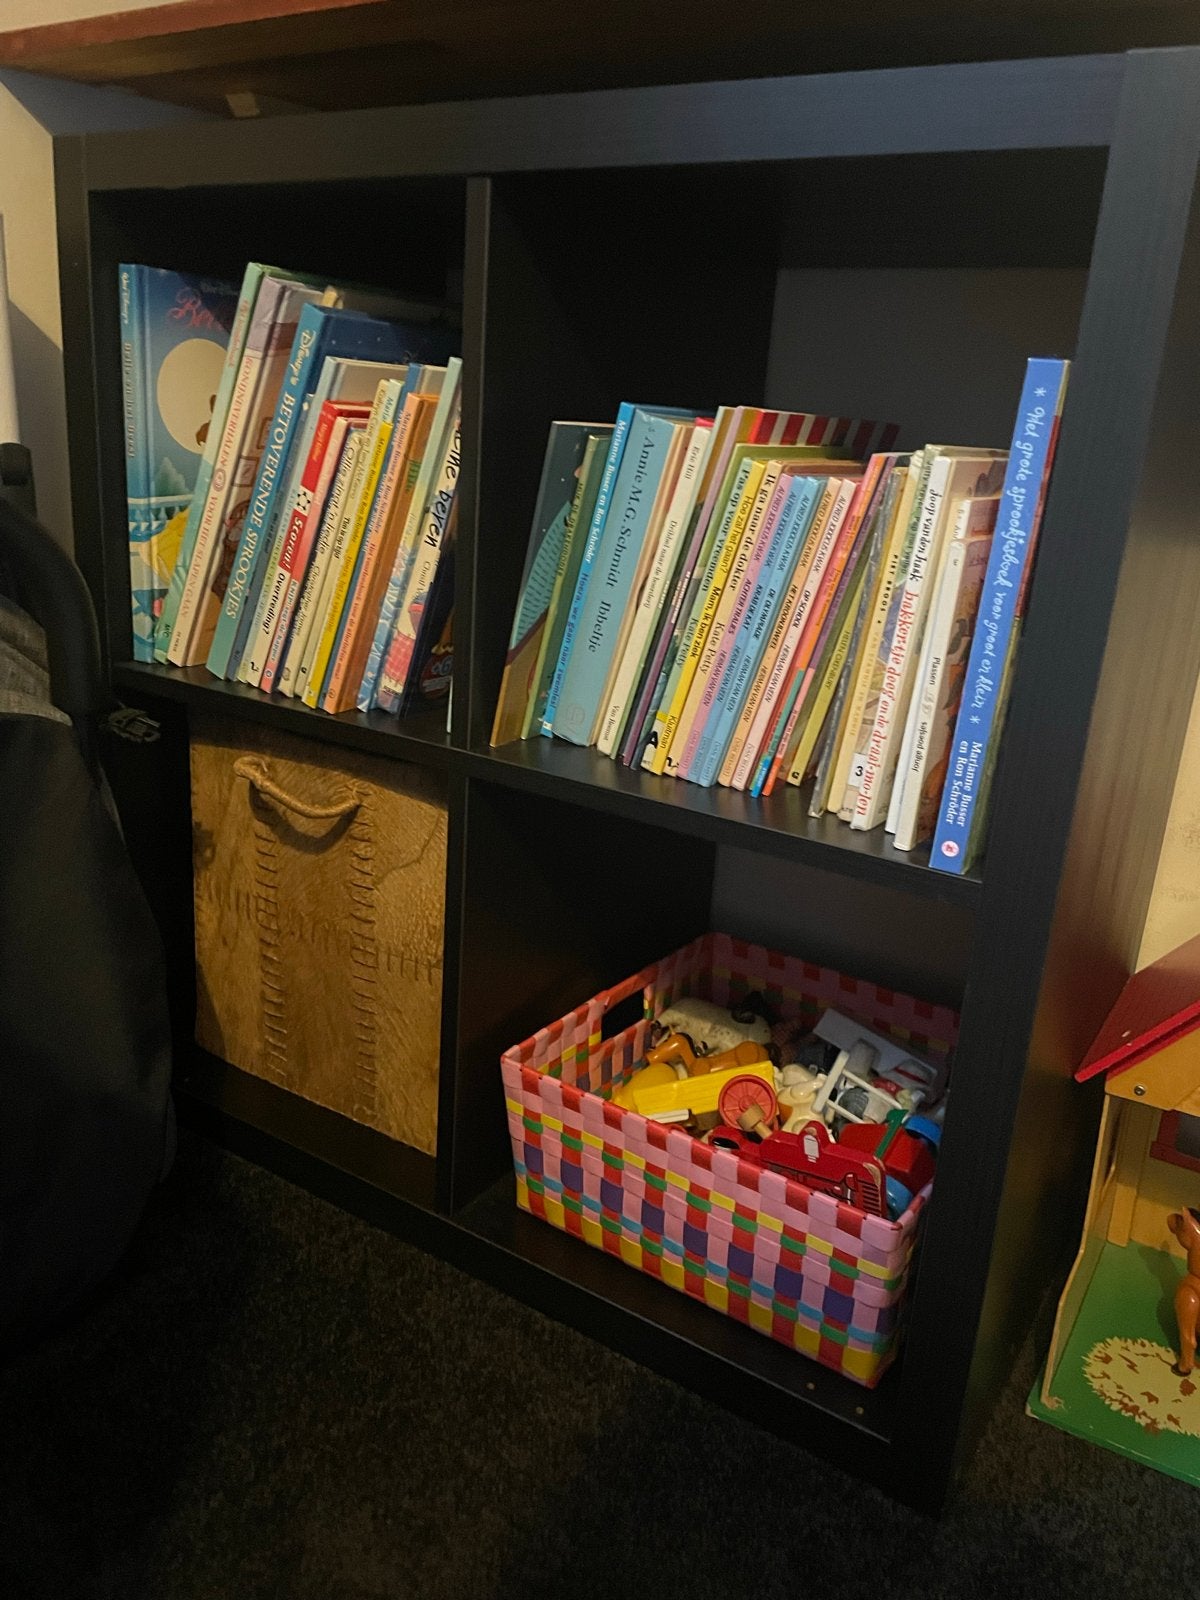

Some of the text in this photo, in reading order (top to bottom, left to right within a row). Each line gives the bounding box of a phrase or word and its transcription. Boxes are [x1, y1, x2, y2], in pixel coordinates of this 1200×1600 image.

[288, 329, 316, 386] Disney's
[396, 412, 411, 447] Marianne
[251, 392, 296, 526] BETOVERENDE
[339, 446, 355, 477] Ollie
[684, 446, 700, 479] Eric Hill
[382, 484, 391, 499] Ron
[423, 488, 453, 548] beren
[584, 419, 626, 563] Marianne Busser en Ron Schröder
[605, 436, 655, 587] Annie M.G. Schmidt
[281, 516, 303, 569] Scoren!
[318, 522, 334, 554] liedje
[335, 534, 344, 544] op
[662, 519, 677, 547] Dribbel
[700, 468, 750, 592] Pas op voor vreemden
[721, 494, 753, 573] Hoe zal het gaan?
[728, 473, 776, 591] Ik ga naar de dokter
[753, 485, 785, 562] ALFRED KWAK
[764, 490, 796, 567] ALFRED KWAK
[777, 493, 810, 571] ALFRED KWAK
[799, 490, 833, 568] ALFRED KWAK
[813, 495, 846, 572] ALFRED KWAK
[909, 488, 943, 582] joop van den haak
[179, 495, 218, 616] VOOR HET SLAPEN GAAN
[225, 526, 258, 617] SPROOKJES
[654, 566, 662, 576] de
[656, 548, 667, 565] naar
[880, 554, 898, 611] PIET BROOS
[970, 405, 1045, 709] Het grote sprookjesboek voor groot en klein
[261, 572, 286, 635] Overtreding?
[642, 575, 659, 608] boerderij
[727, 578, 752, 634] ACHTER TRALIES
[742, 583, 763, 629] KRAB DE KAT
[752, 587, 776, 639] DE OLYMPIADE
[769, 584, 798, 649] HET KROONJUWEEL
[791, 589, 811, 628] OP SCHOOL
[268, 634, 282, 660] kapper
[278, 624, 285, 632] de
[548, 572, 589, 708] Hoera, we gaan naar zwemles!
[587, 599, 611, 653] Ibbeltje
[675, 617, 698, 668] Kate Petty
[689, 585, 721, 658] Mam, ik ben ziek
[699, 621, 725, 672] Kate Petty
[837, 630, 849, 652] HELEN
[702, 649, 727, 707] HERMAN VAN VEEN
[715, 644, 741, 702] HERMAN VAN VEEN
[725, 654, 752, 712] HERMAN VAN VEEN
[742, 665, 768, 722] HERMAN VAN VEEN
[764, 643, 791, 702] HERMAN VAN VEEN
[824, 653, 842, 690] OXENBURY
[880, 666, 902, 700] deeg
[928, 656, 940, 685] Plassen
[610, 704, 620, 717] Van
[876, 715, 889, 728] de
[879, 700, 889, 714] en
[855, 765, 864, 777] 3
[944, 740, 968, 824] en Ron Schröder
[955, 741, 983, 826] Marianne Busser
